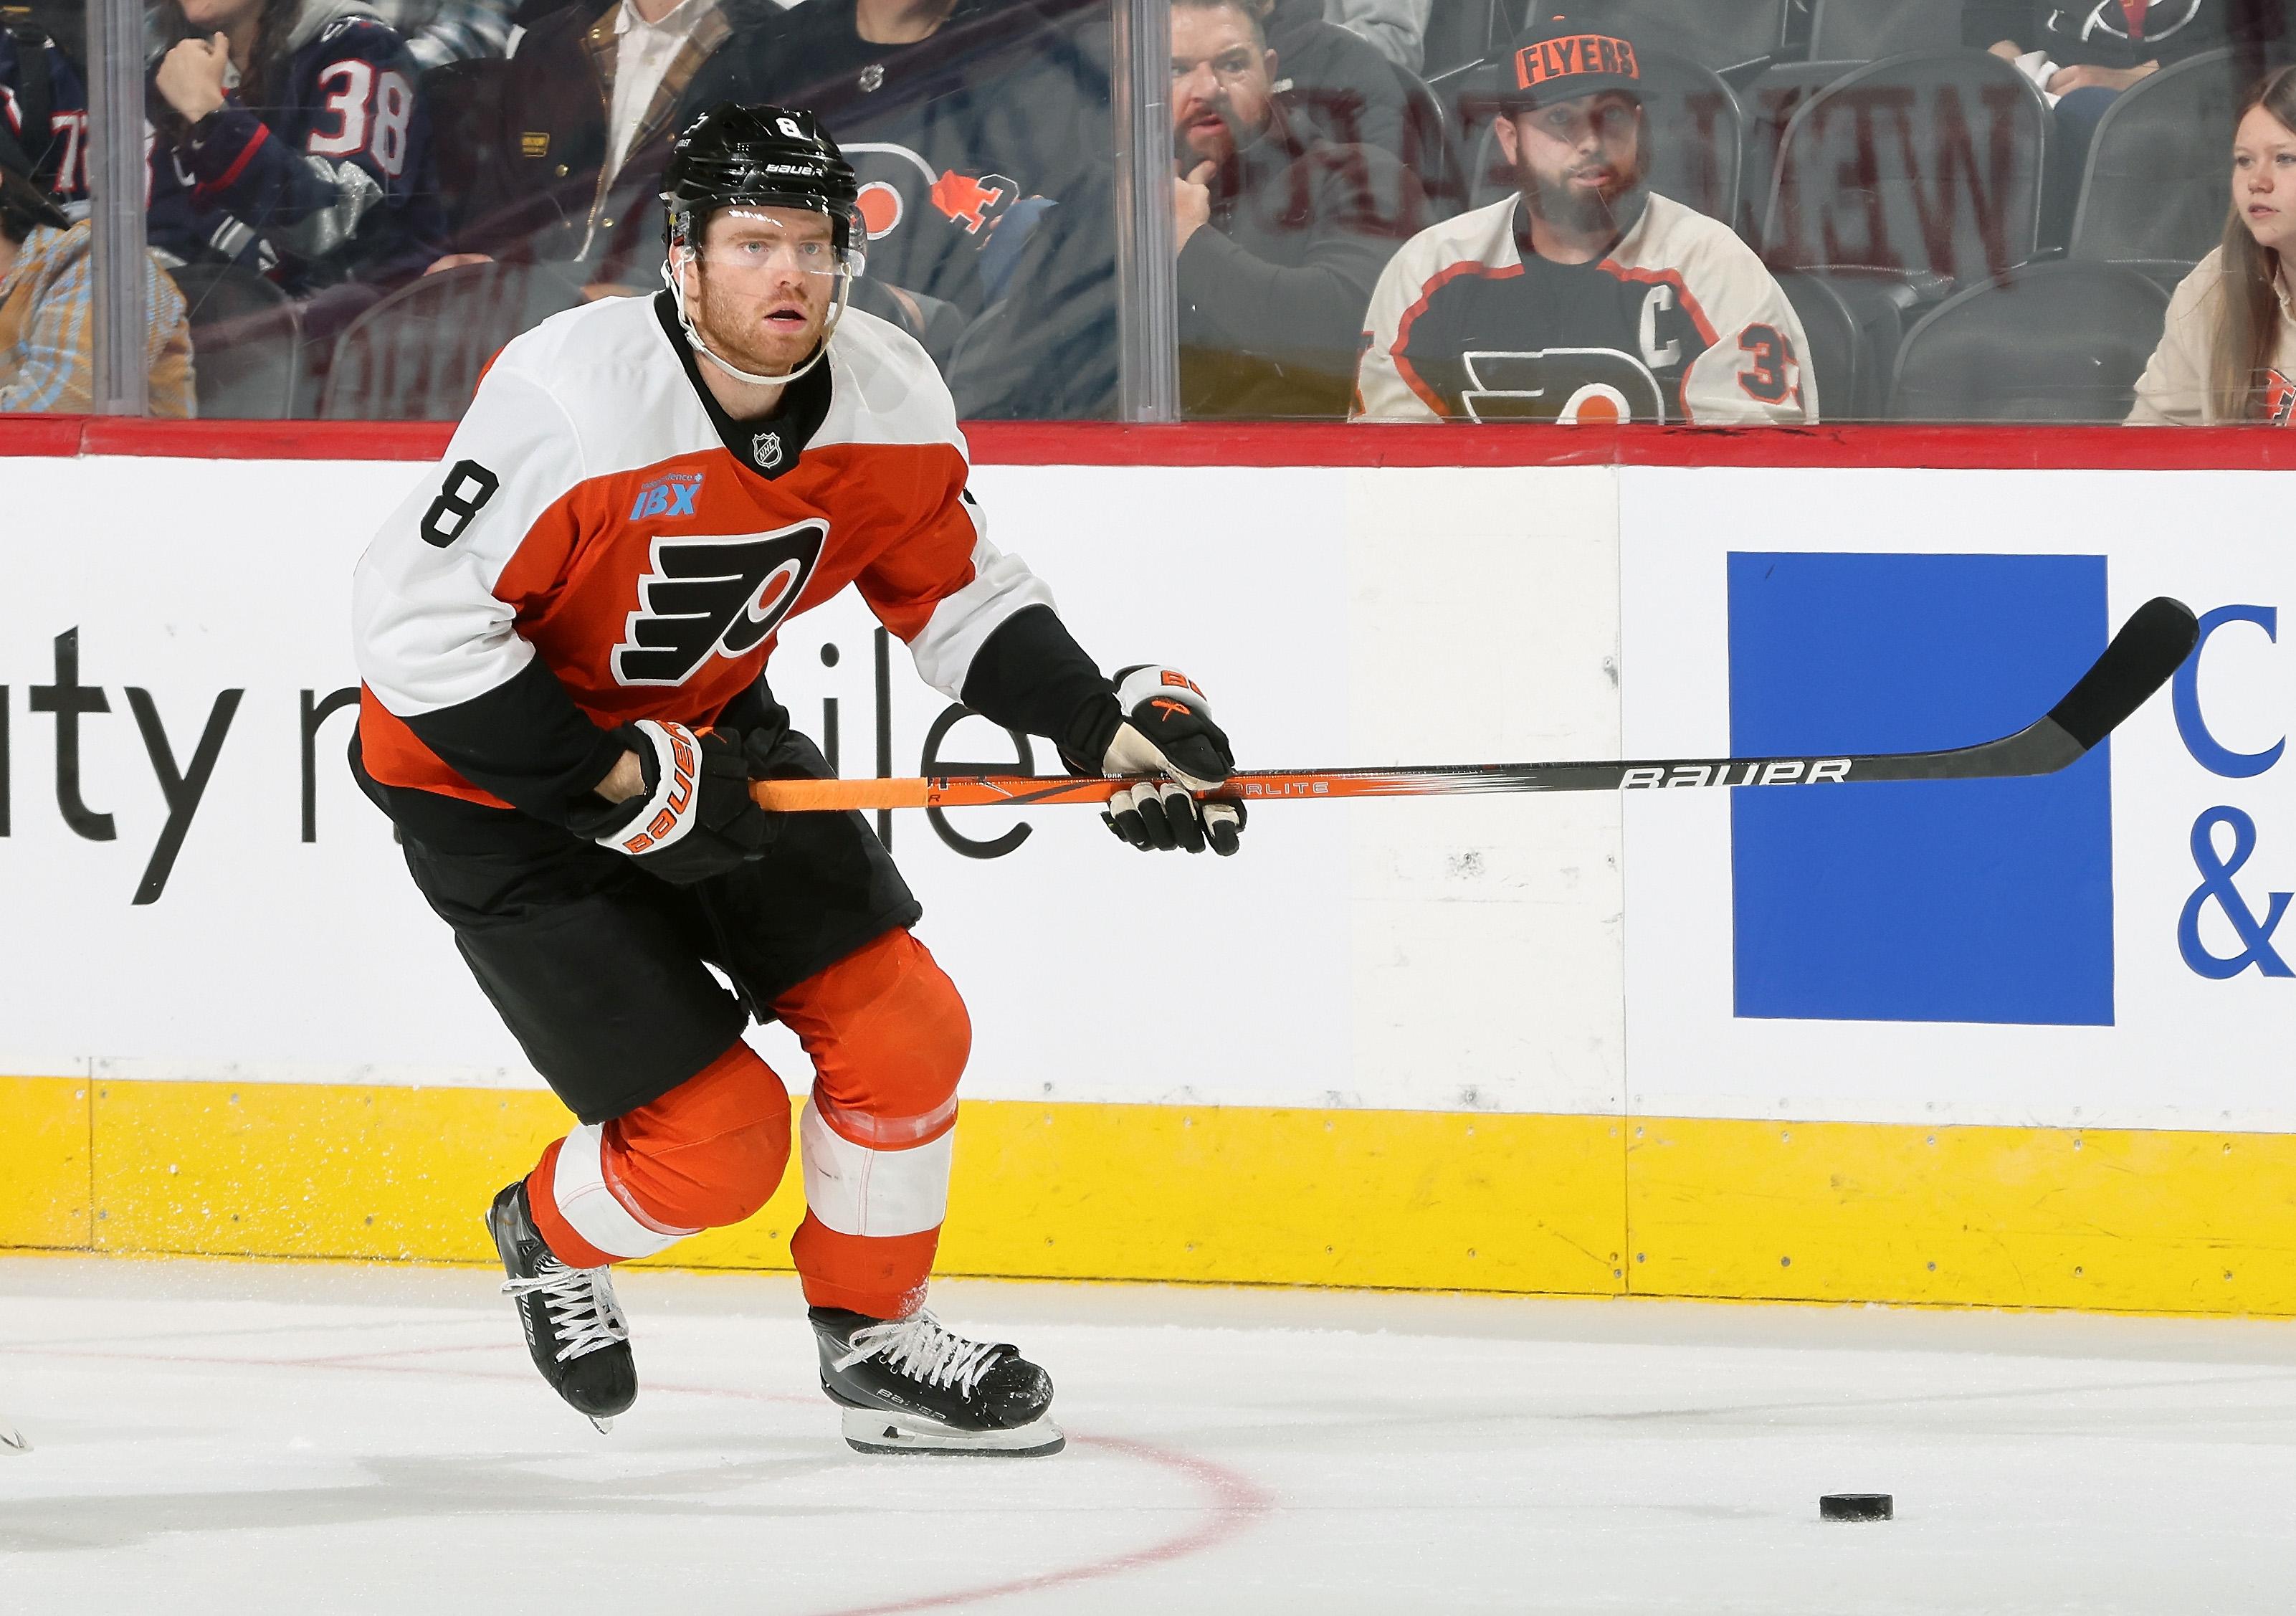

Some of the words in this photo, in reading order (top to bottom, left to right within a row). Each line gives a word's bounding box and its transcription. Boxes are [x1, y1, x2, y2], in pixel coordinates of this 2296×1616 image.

[1521, 37, 1634, 84] FLYERS
[306, 57, 414, 178] 38
[775, 117, 801, 138] 8
[765, 163, 826, 177] BAUER
[1639, 285, 1681, 369] C
[760, 442, 774, 460] NHL
[421, 460, 499, 548] 8
[629, 483, 700, 521] IBX
[2172, 604, 2287, 779] C
[0, 625, 245, 905] ty
[622, 720, 695, 854] BAUER
[1618, 759, 1853, 789] BAUER
